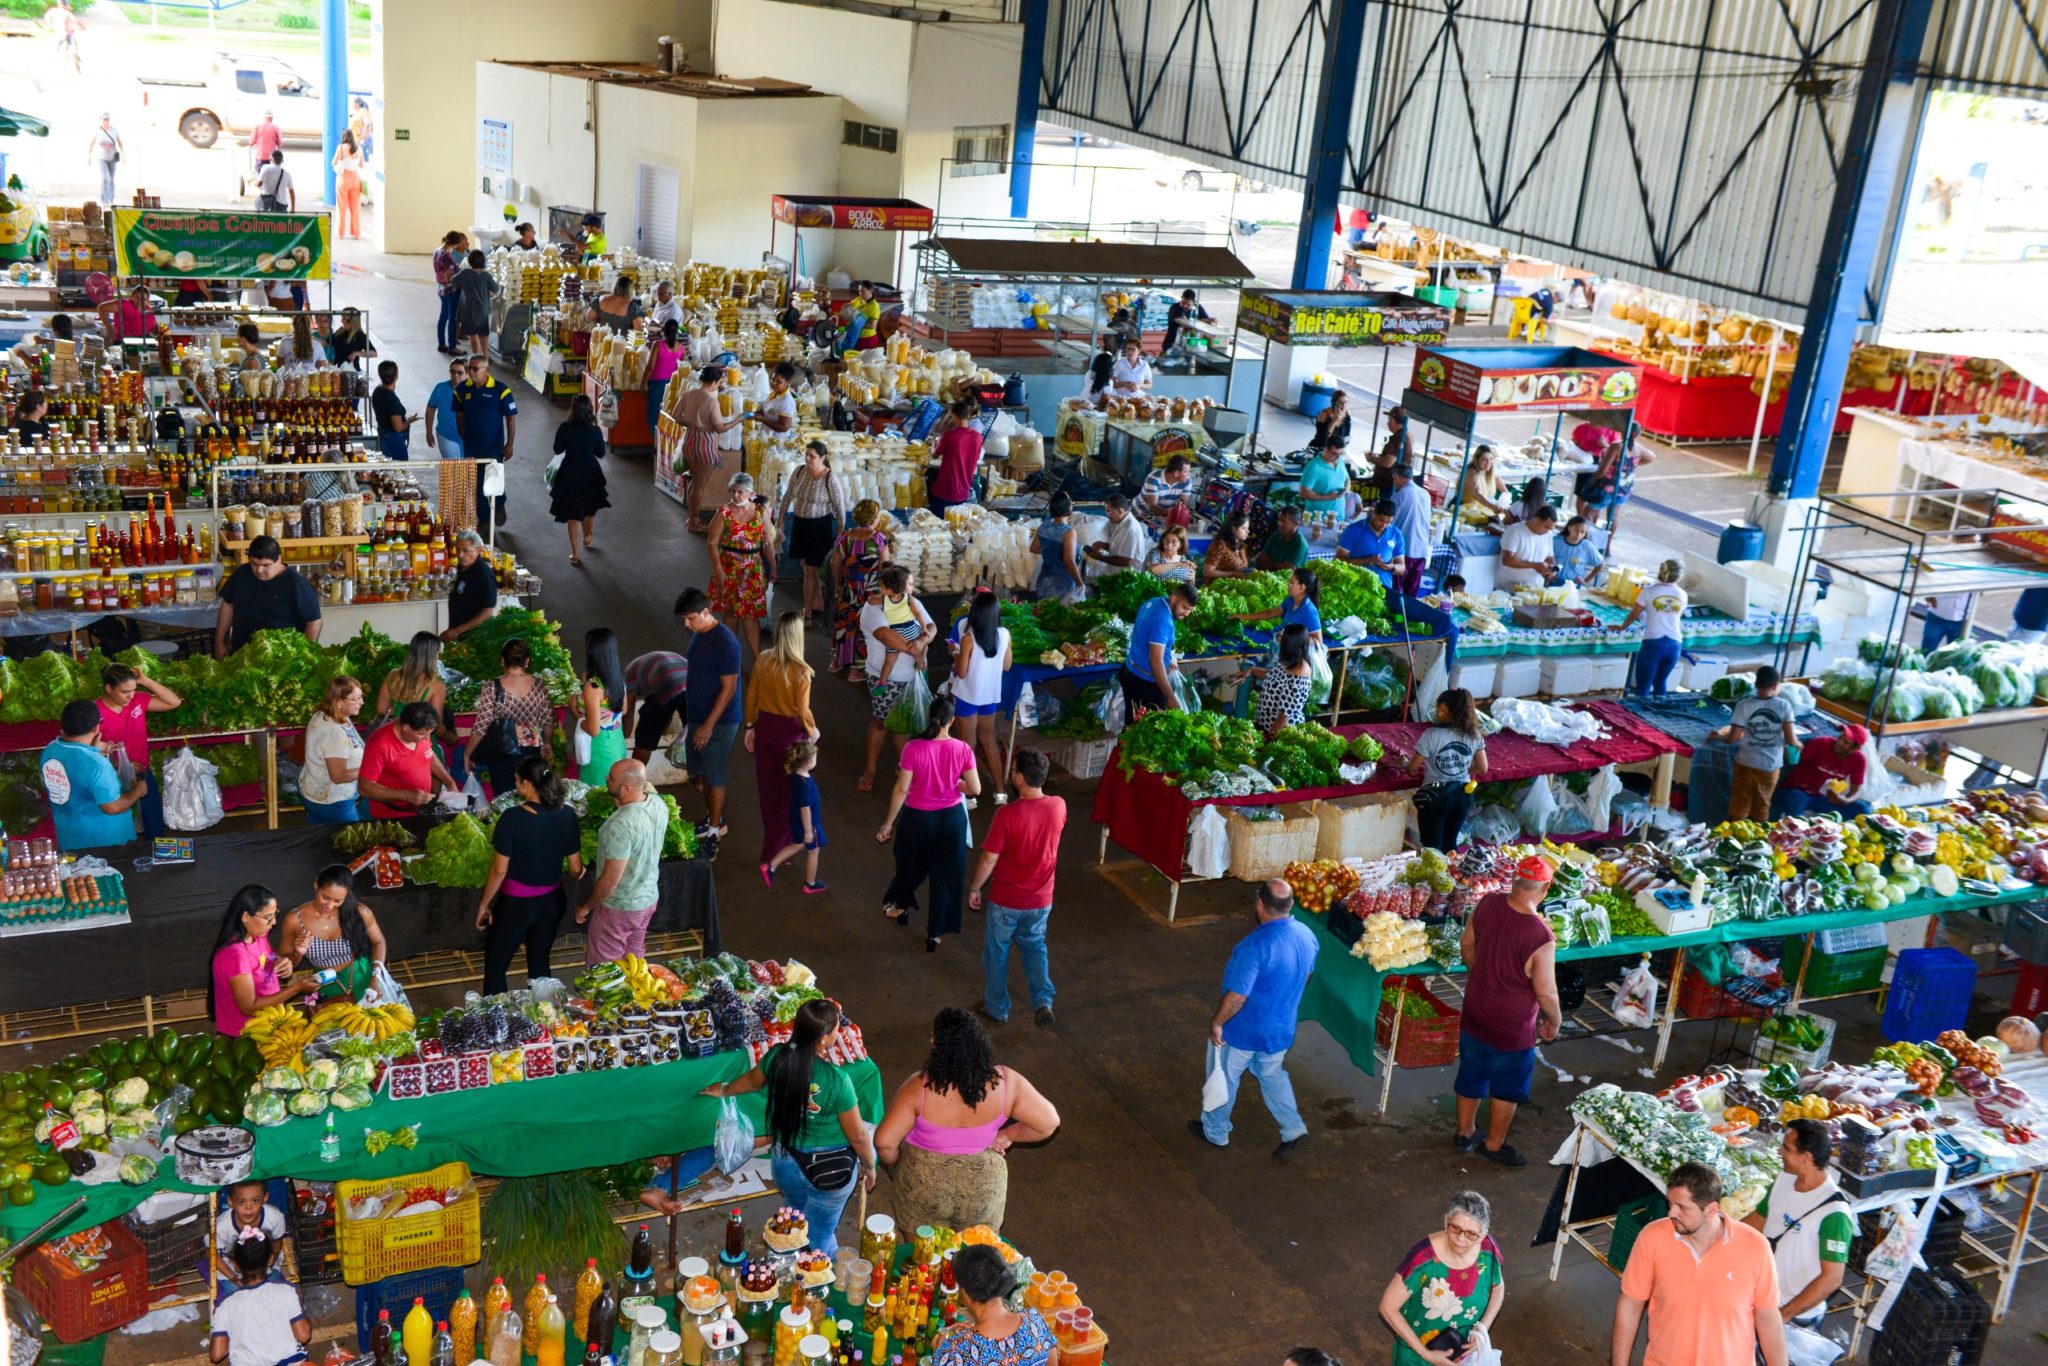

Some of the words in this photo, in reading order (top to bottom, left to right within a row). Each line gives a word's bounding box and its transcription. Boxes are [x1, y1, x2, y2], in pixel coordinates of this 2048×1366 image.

[848, 209, 873, 221] BOLO
[143, 213, 220, 235] Queijos
[225, 214, 304, 234] Colmeia
[852, 219, 885, 230] ARROZ
[1295, 312, 1321, 334] Rei
[1323, 311, 1360, 335] Café
[1362, 313, 1384, 335] TO
[1435, 753, 1460, 763] Mundo
[393, 1230, 433, 1242] PANEBRAS
[91, 1281, 125, 1300] TOMATINS
